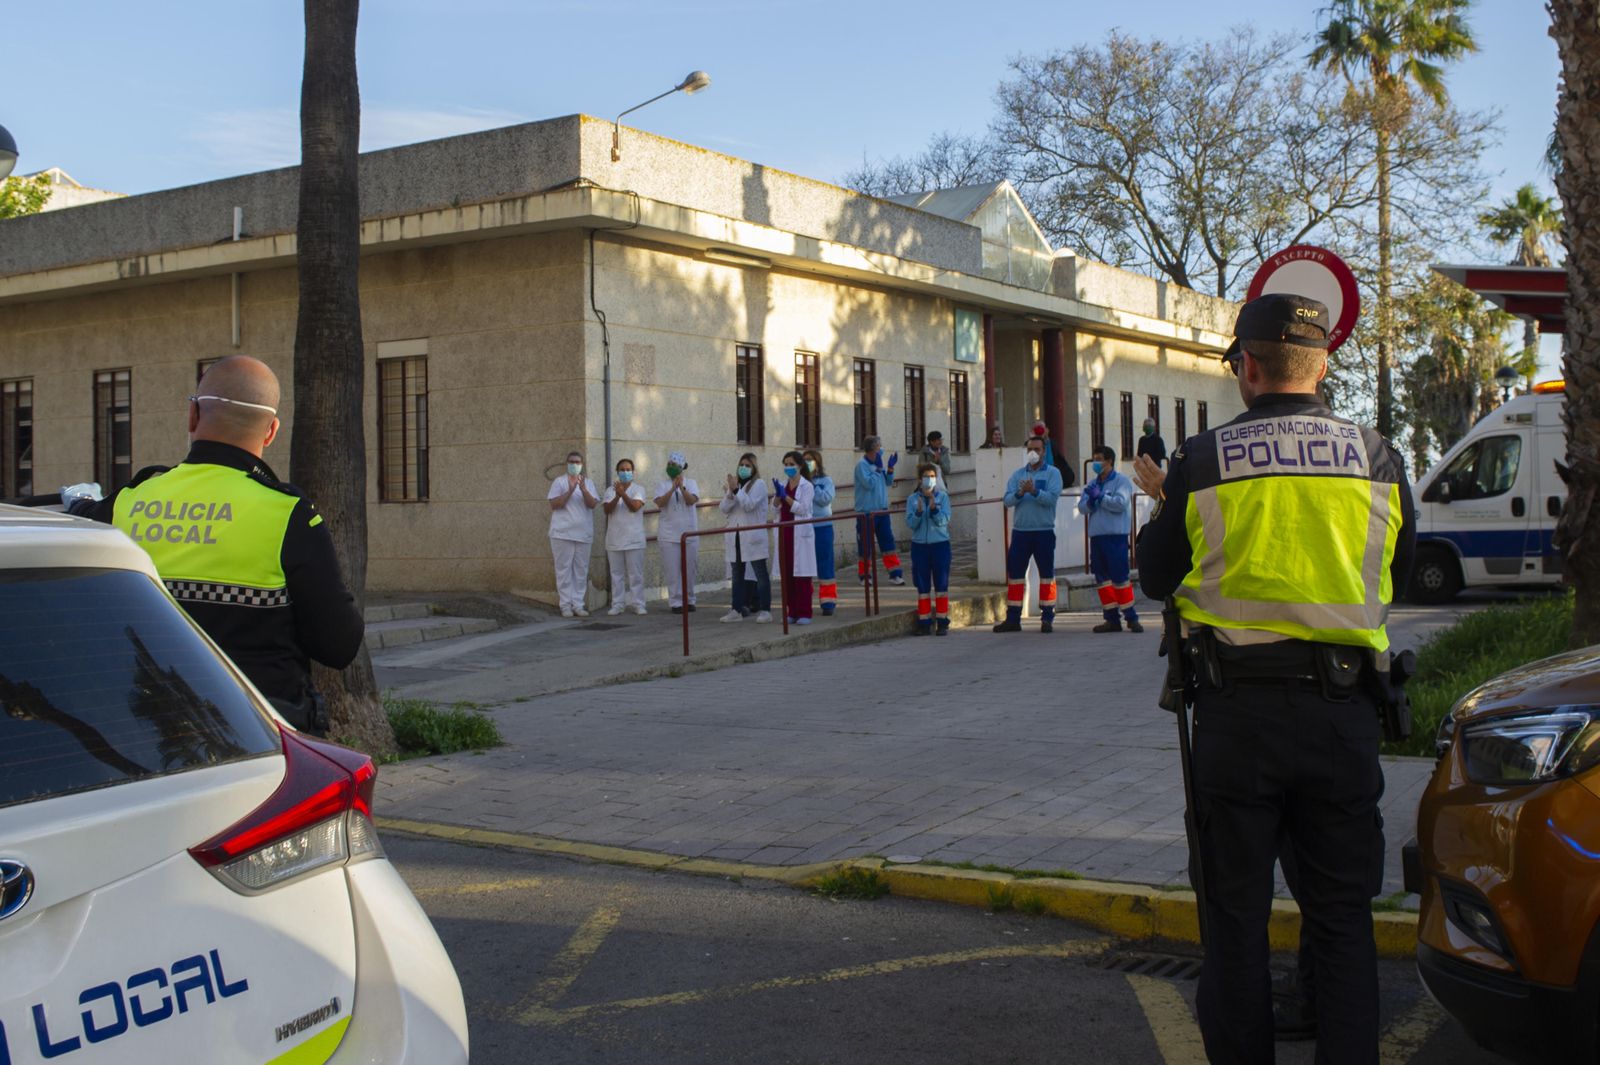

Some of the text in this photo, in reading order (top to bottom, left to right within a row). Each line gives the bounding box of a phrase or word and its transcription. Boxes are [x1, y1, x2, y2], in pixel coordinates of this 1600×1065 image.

[1274, 249, 1325, 267] EXCEPTO
[1295, 307, 1319, 319] CNP
[1221, 421, 1358, 442] CUERPO NACIONAL DE
[1222, 440, 1364, 472] POLICIA
[128, 500, 233, 522] POLICIA
[129, 523, 217, 545] LOCAL
[31, 948, 250, 1059] LOCAL
